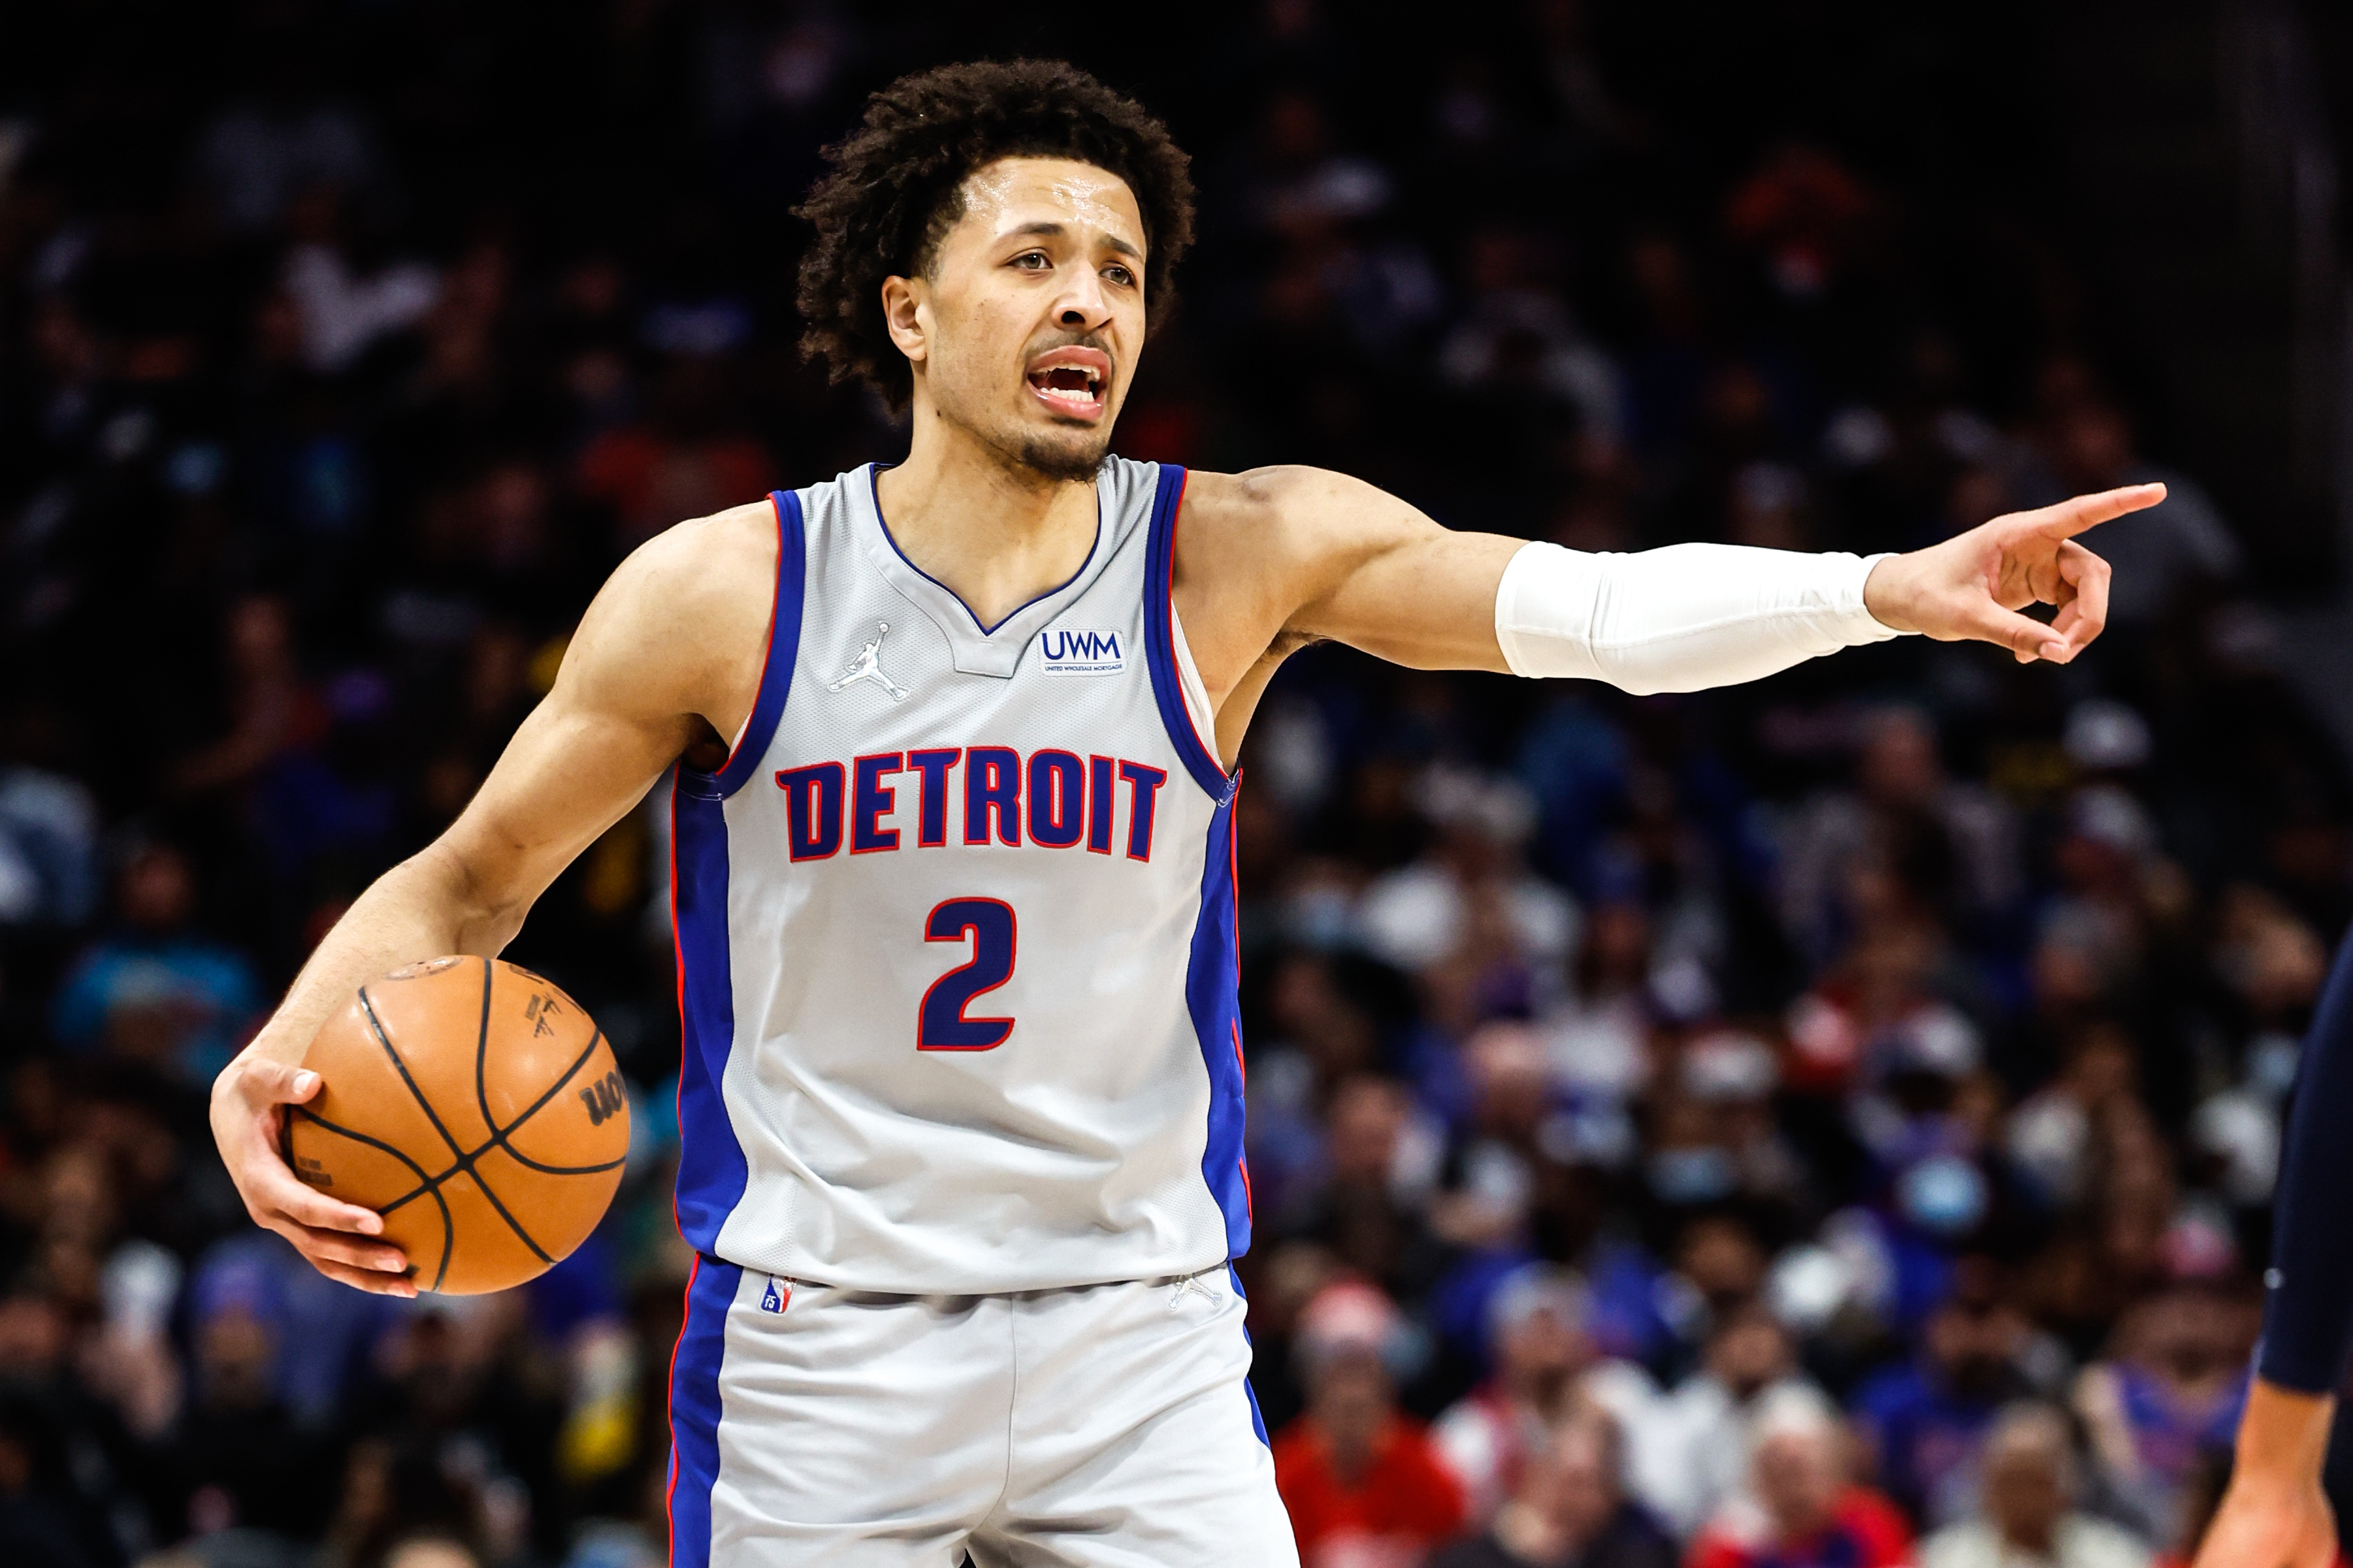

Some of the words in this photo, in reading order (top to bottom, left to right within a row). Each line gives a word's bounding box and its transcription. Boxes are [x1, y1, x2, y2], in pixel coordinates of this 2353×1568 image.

[1042, 632, 1120, 660] UWM
[775, 746, 1167, 863] DETROIT
[917, 896, 1017, 1052] 2
[764, 1294, 777, 1309] 75
